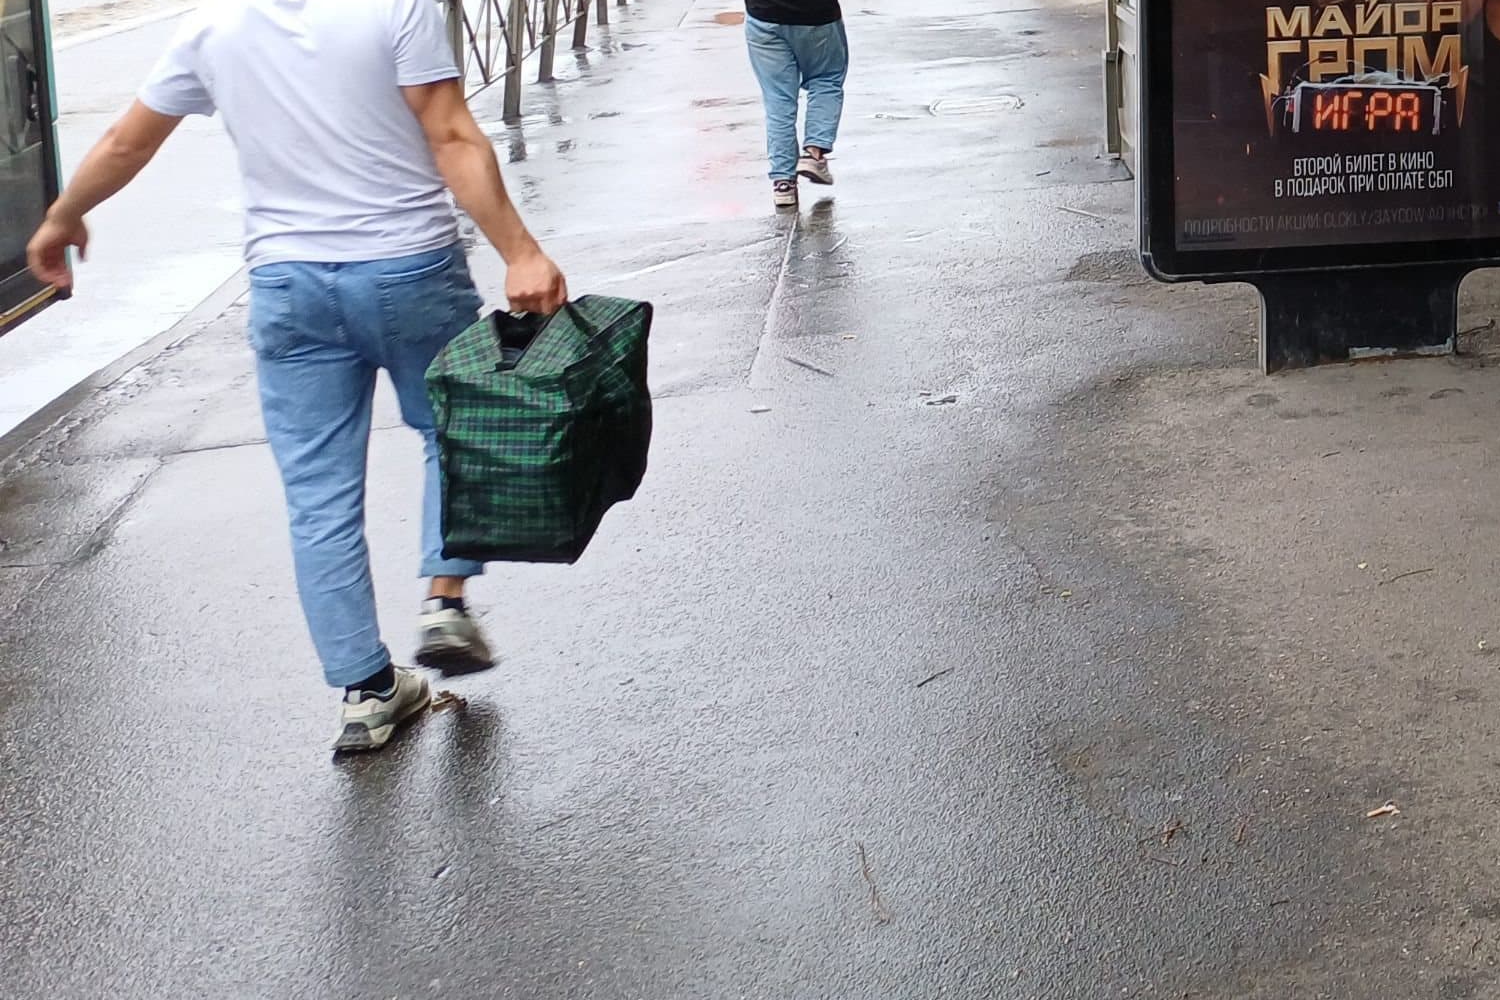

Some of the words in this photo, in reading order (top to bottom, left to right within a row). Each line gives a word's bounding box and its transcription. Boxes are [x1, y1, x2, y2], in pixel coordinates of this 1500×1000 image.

[1259, 33, 1469, 125] ГРОМ
[1315, 91, 1421, 131] ИГРА
[1293, 153, 1342, 177] ВТОРОЙ
[1345, 153, 1385, 174] БИЛЕТ
[1388, 152, 1397, 171] В
[1400, 150, 1435, 170] КИНО
[1274, 178, 1283, 198] В
[1287, 175, 1346, 198] ПОДАРОК
[1349, 174, 1375, 193] ПРИ
[1378, 171, 1425, 192] ОПЛАТЕ
[1428, 169, 1453, 188] СБП
